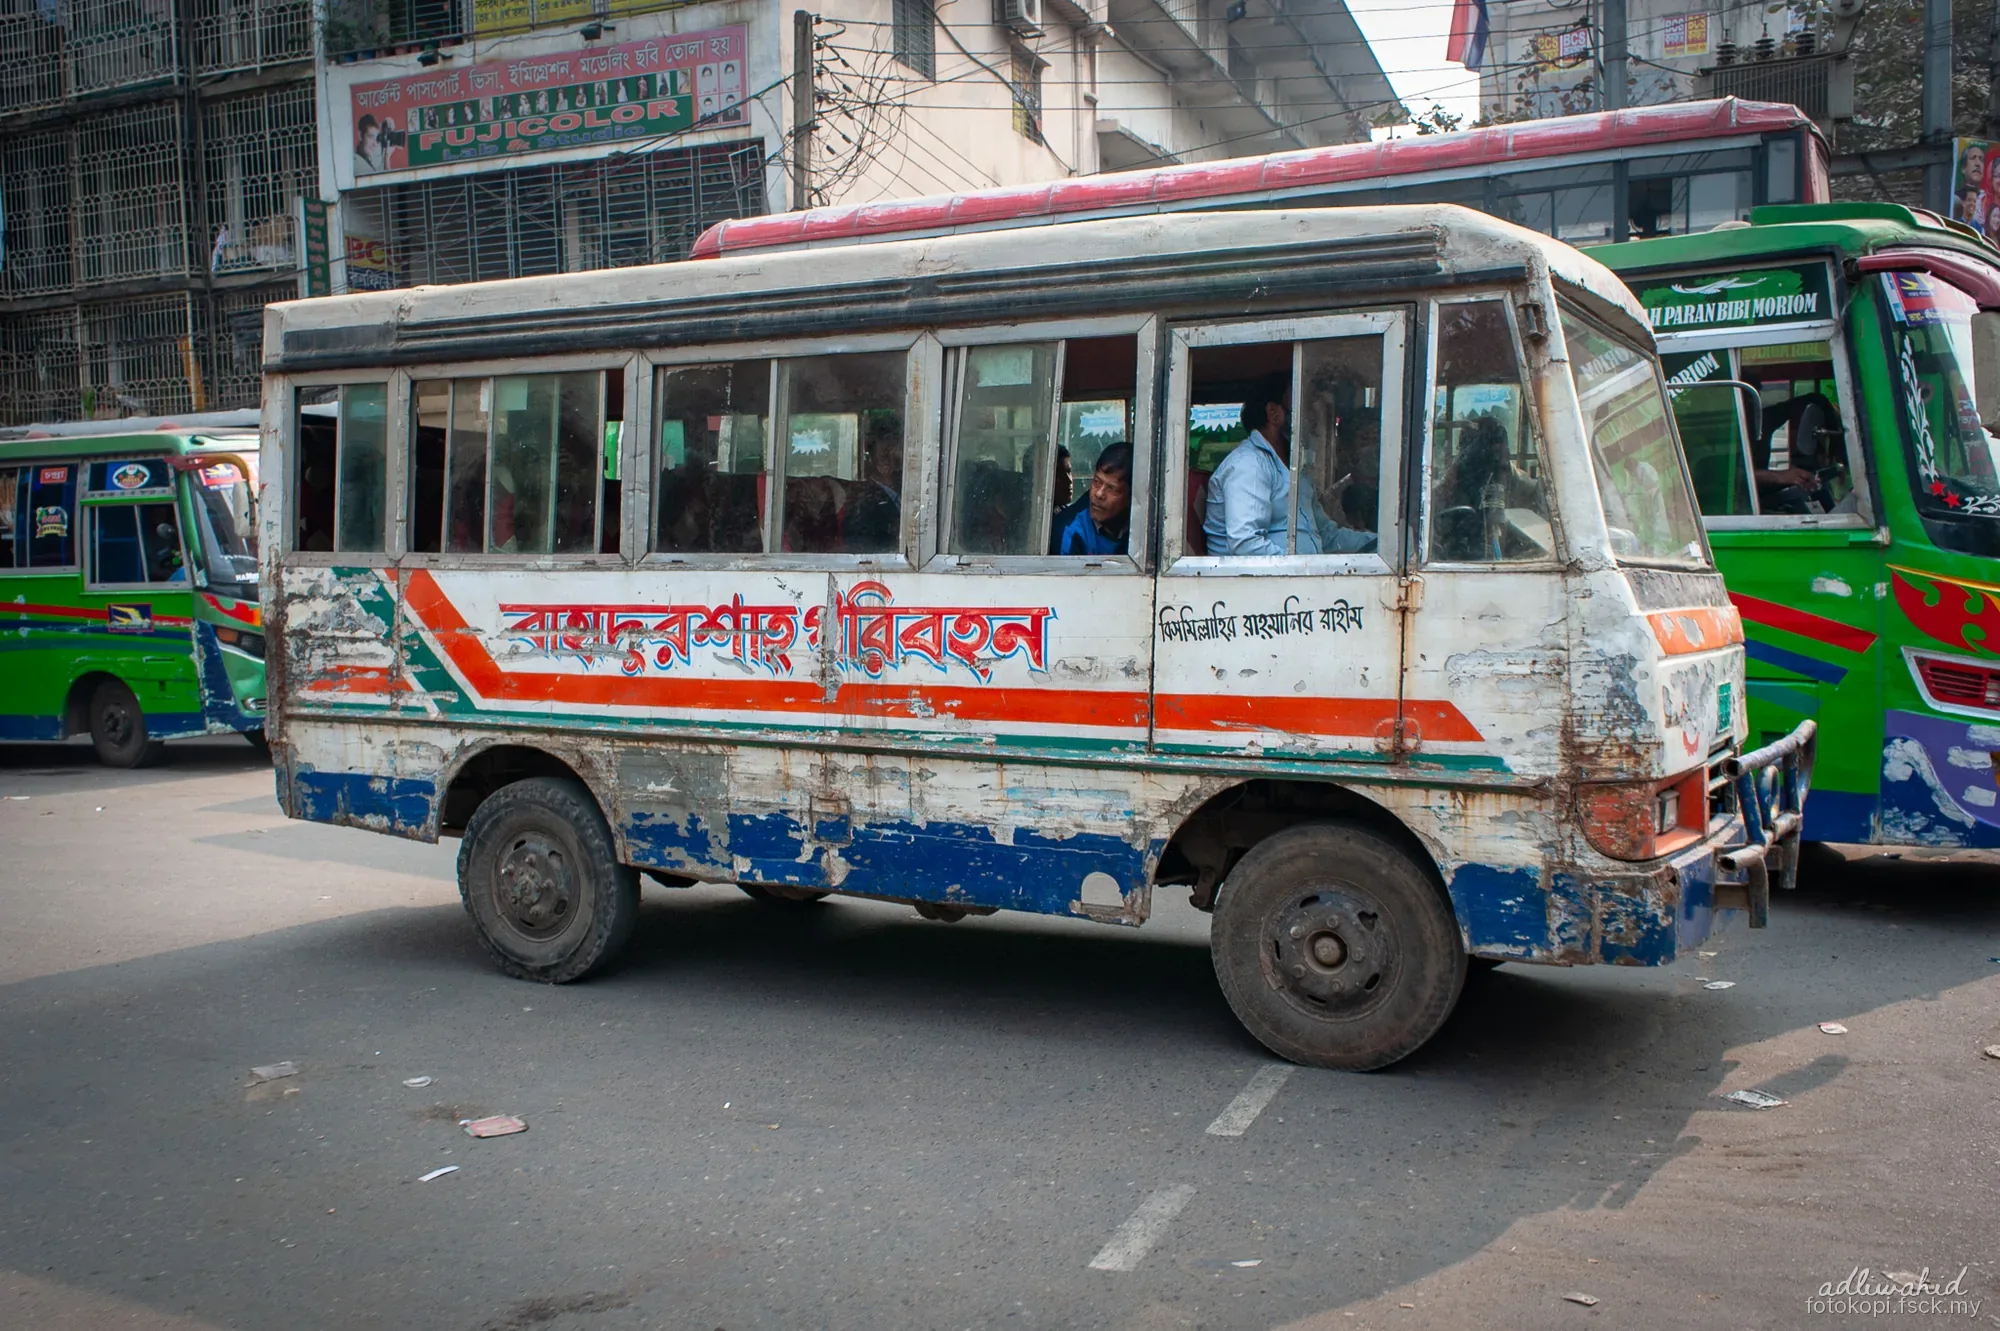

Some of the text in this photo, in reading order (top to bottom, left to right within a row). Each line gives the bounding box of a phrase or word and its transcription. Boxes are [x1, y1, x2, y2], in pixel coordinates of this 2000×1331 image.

[1563, 31, 1586, 46] BCS
[580, 47, 631, 75] মডেলিং
[635, 41, 659, 69] ছবি
[665, 39, 705, 63] তোলা
[419, 99, 681, 151] FUJICOLOR
[443, 143, 498, 162] Lab
[538, 124, 645, 148] Studio
[1664, 303, 1716, 326] PARAN
[1714, 299, 1750, 322] BIBI
[1752, 292, 1817, 318] MORIOM
